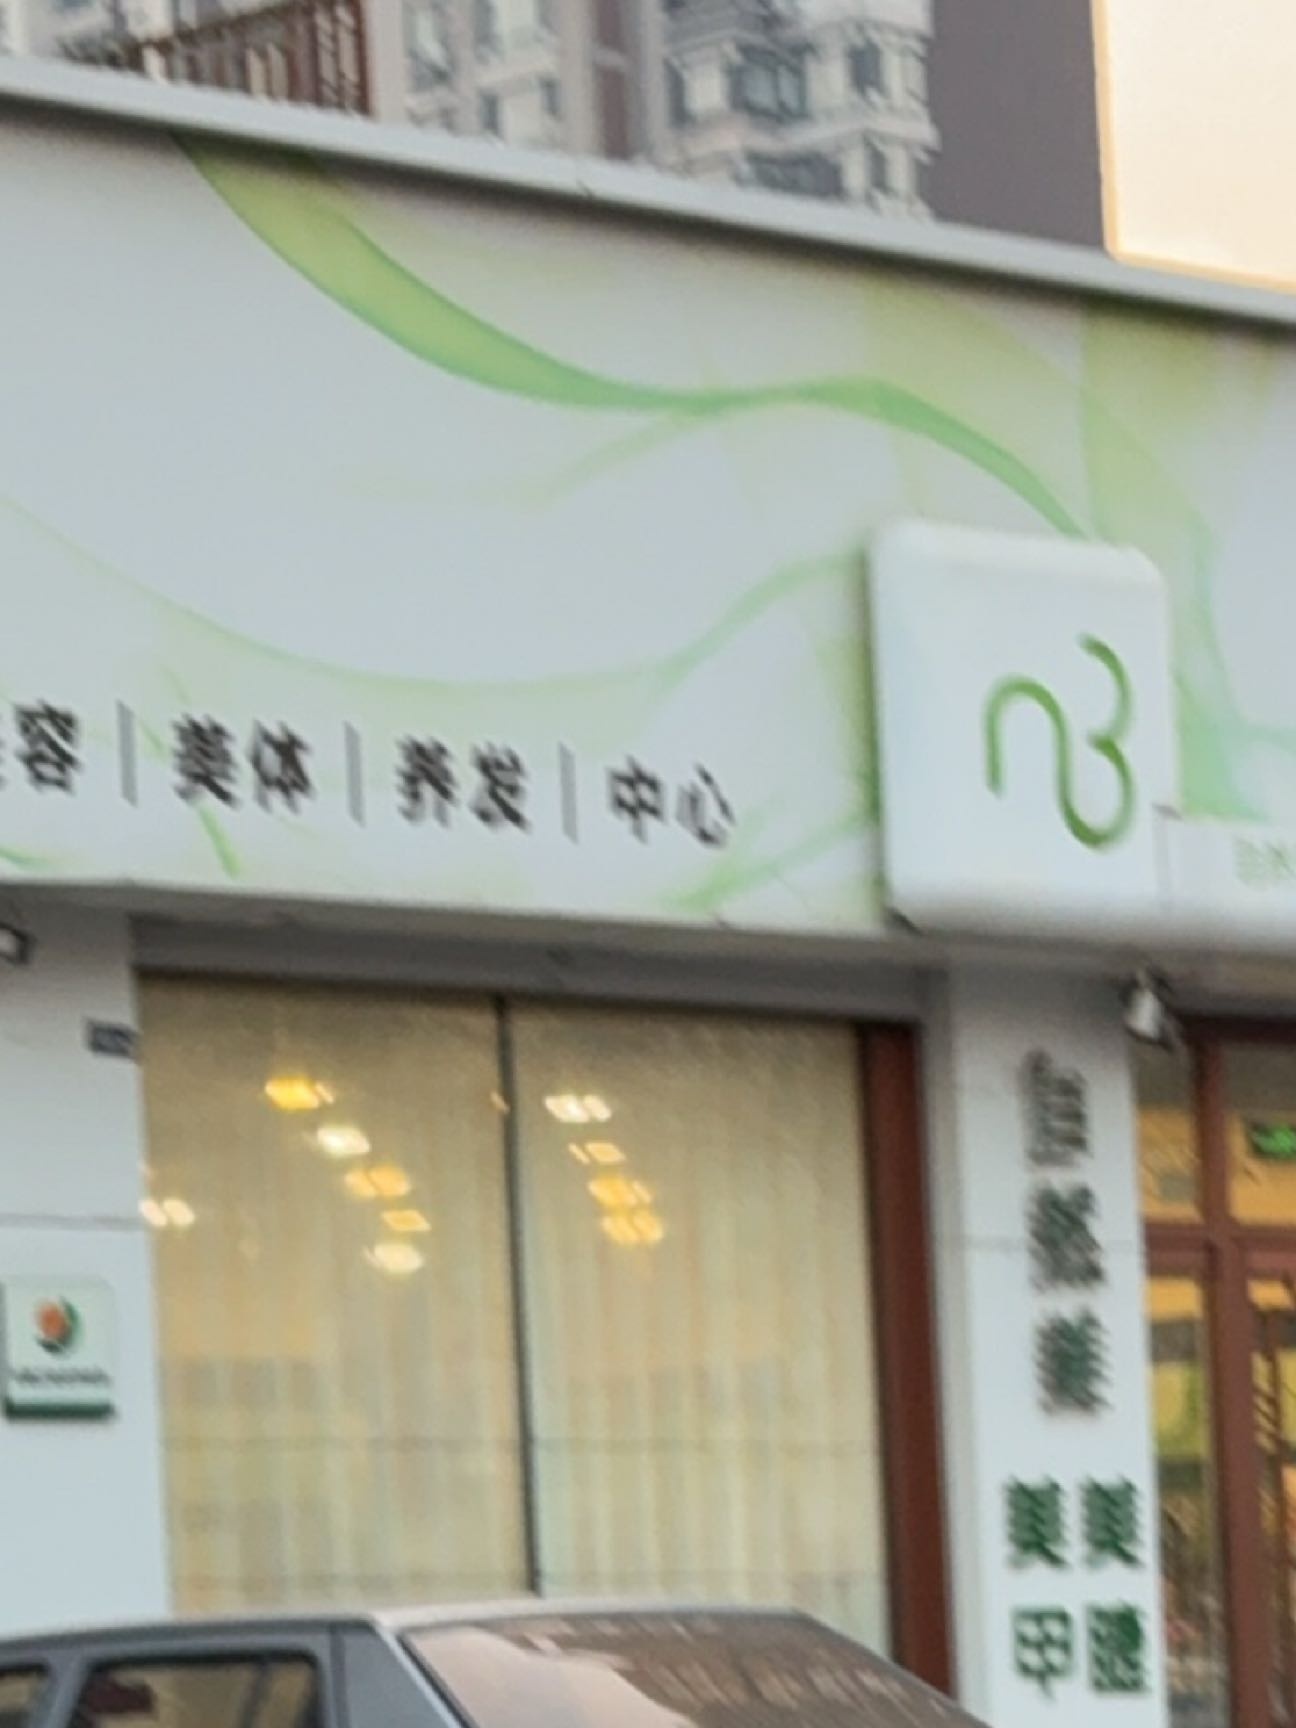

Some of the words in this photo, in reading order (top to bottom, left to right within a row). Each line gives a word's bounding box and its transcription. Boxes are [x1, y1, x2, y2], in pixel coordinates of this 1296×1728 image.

[0, 702, 78, 794] 容
[172, 714, 312, 812] 美体
[398, 734, 530, 832] 养发
[608, 757, 734, 847] 中心
